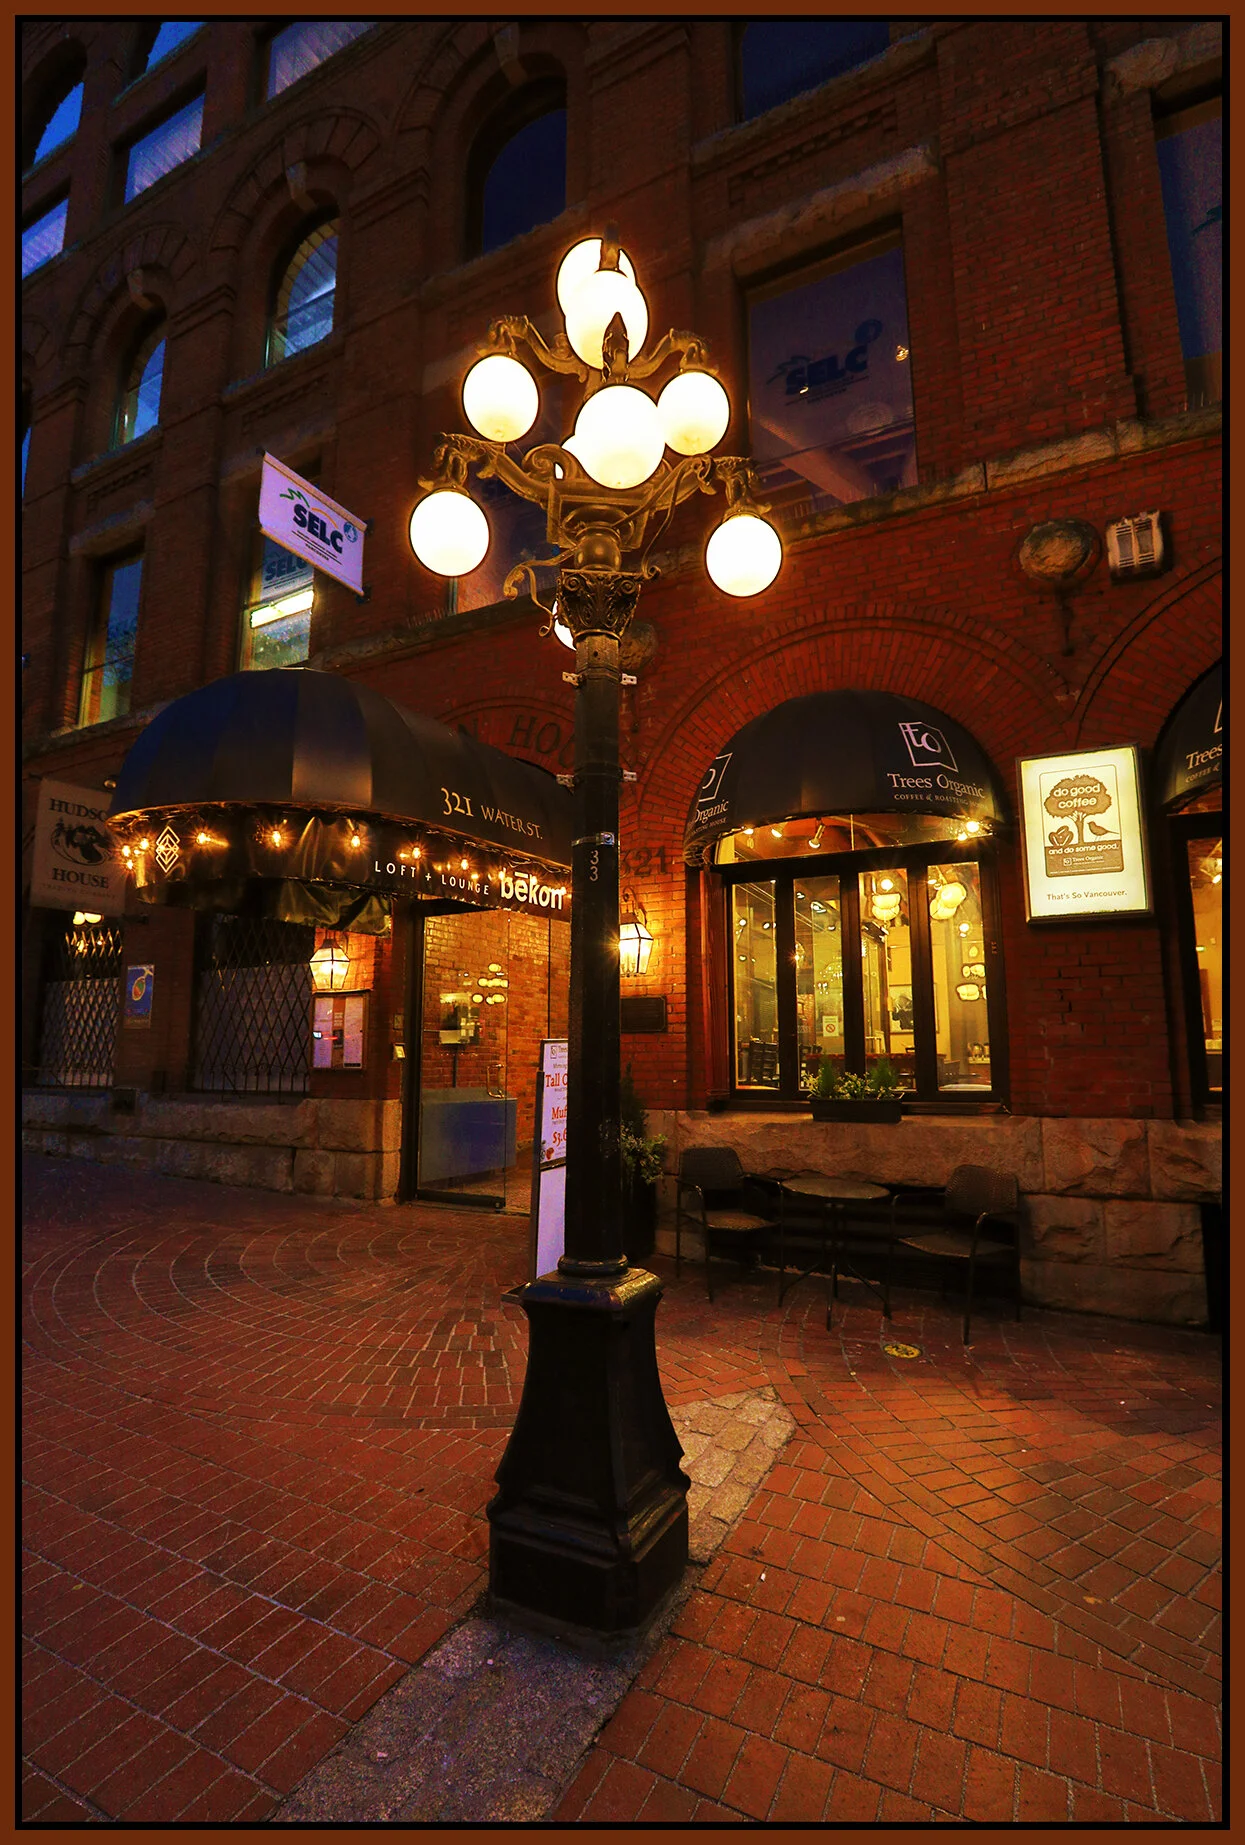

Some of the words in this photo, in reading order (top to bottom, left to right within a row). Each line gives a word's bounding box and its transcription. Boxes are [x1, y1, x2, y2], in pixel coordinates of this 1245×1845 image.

[786, 345, 868, 395] SELC
[293, 504, 343, 554] SELC
[1185, 743, 1222, 770] Trees
[887, 773, 933, 788] Trees
[936, 773, 985, 798] Organic
[894, 793, 924, 801] COFFEE
[1053, 787, 1068, 797] do
[1070, 783, 1100, 796] good
[49, 798, 109, 824] HUDSO
[441, 787, 475, 818] 321
[481, 805, 526, 834] WATER
[523, 821, 544, 840] ST.
[1058, 797, 1097, 809] coffee
[1048, 847, 1063, 855] and
[1064, 846, 1075, 854] do
[1075, 844, 1096, 853] some
[53, 867, 109, 889] HOUSE
[375, 860, 417, 878] LOFT
[441, 874, 490, 895] LOUNGE
[1047, 893, 1069, 901] That's
[1084, 889, 1128, 898] Vancouver.
[546, 1073, 560, 1087] Tall
